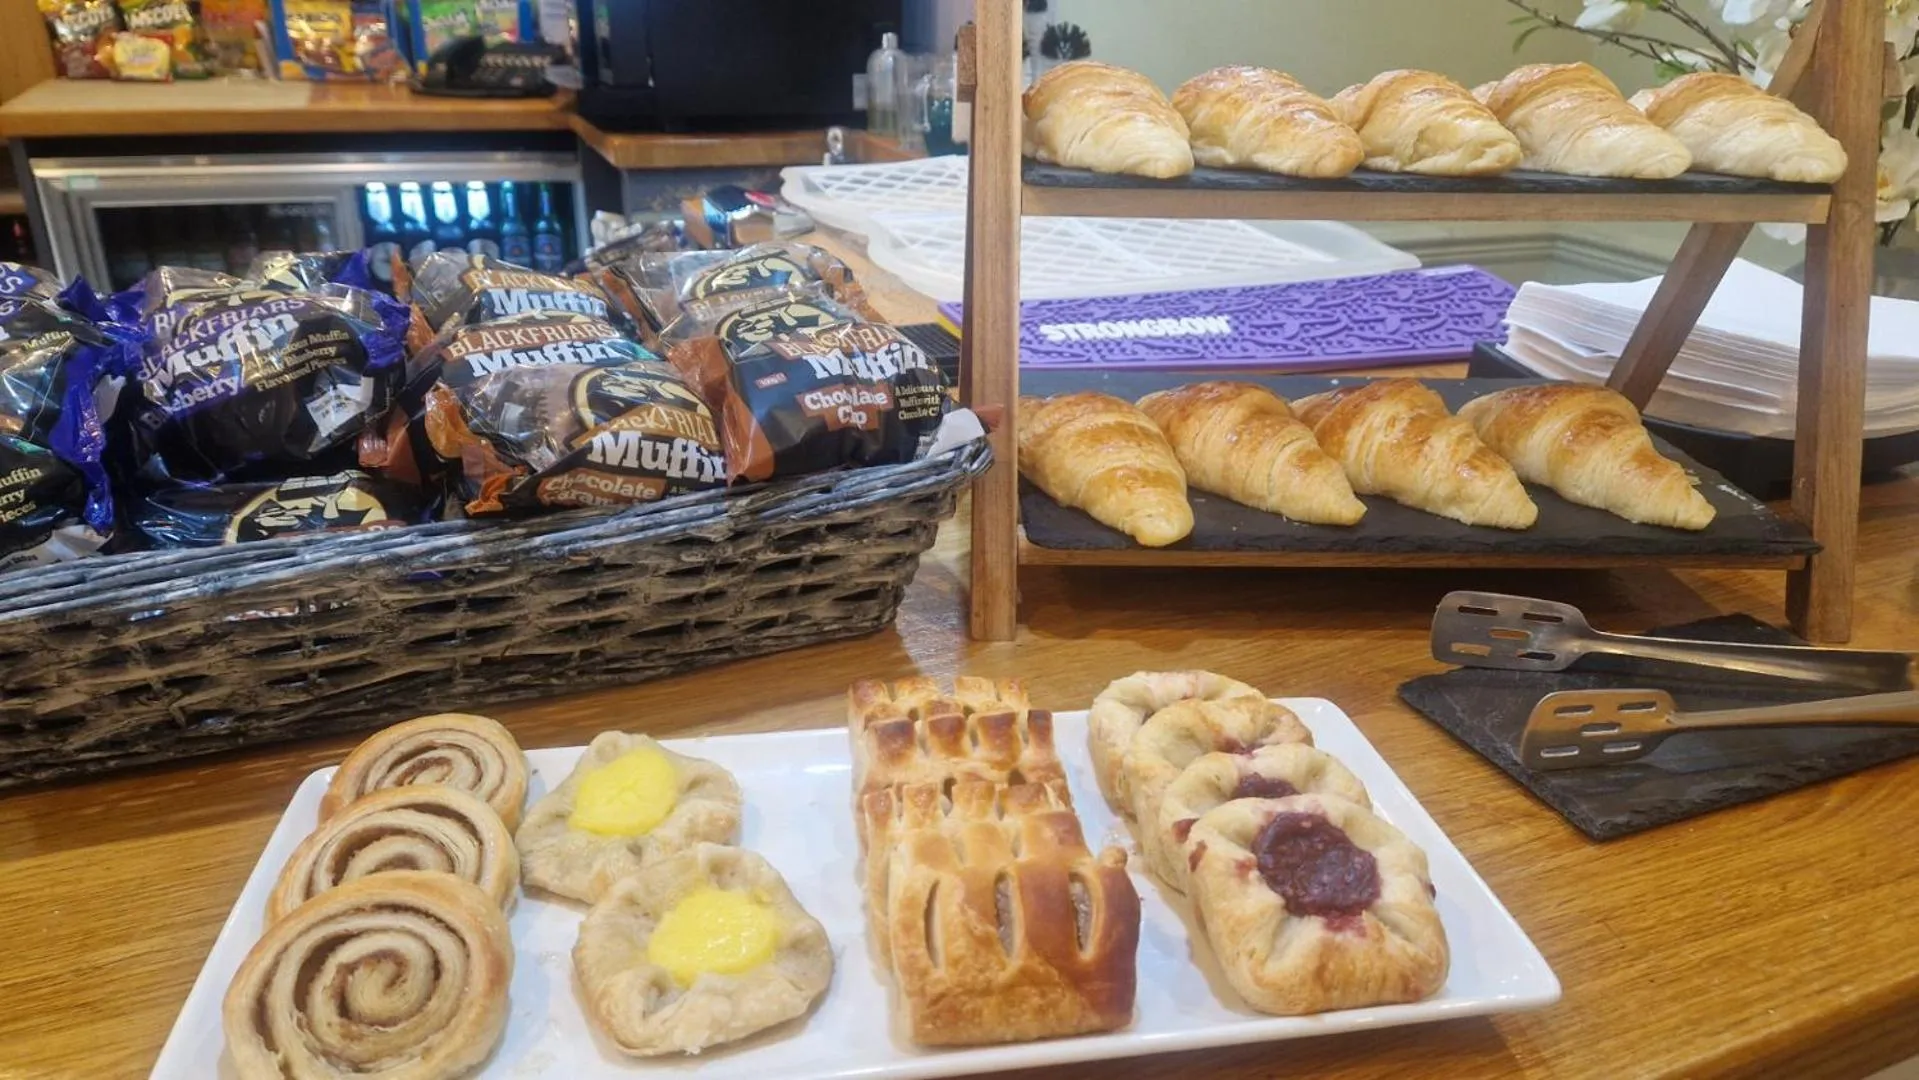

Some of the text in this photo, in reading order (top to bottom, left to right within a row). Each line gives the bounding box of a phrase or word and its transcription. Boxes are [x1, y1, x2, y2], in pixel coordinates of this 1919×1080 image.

[487, 287, 609, 318] Muffin
[22, 331, 71, 350] Muffin
[307, 329, 350, 347] Muffin
[447, 322, 616, 359] BLACKFRIARS
[1040, 316, 1230, 341] STRONGBOW
[143, 313, 300, 398] Muffin
[465, 341, 619, 378] Muffin
[254, 362, 313, 392] Flavoured
[588, 430, 728, 484] Muffin
[0, 467, 42, 489] uffin
[546, 474, 658, 500] Chocolate
[543, 489, 615, 506] Caram
